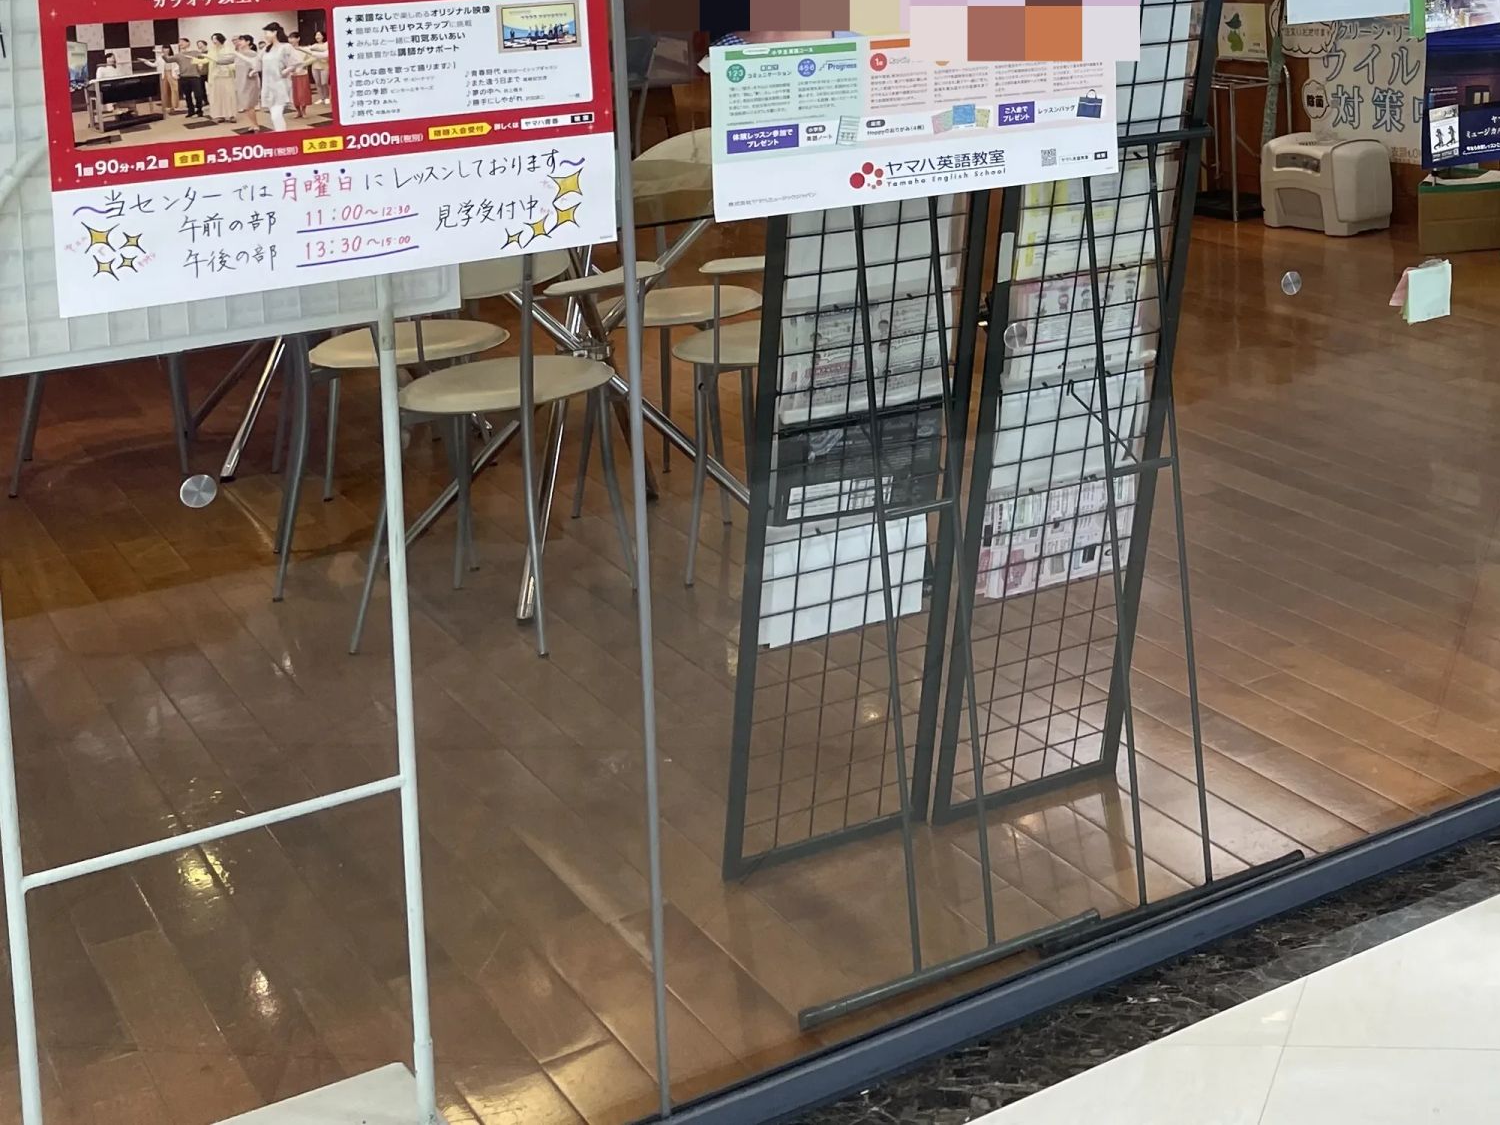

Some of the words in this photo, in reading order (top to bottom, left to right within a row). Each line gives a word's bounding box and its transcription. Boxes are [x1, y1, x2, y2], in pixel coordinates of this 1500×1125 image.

[885, 149, 1006, 177] ヤマハ英語教室
[179, 210, 278, 243] 午前の部
[436, 195, 539, 231] 見学受付中
[183, 244, 278, 278] 午後の部
